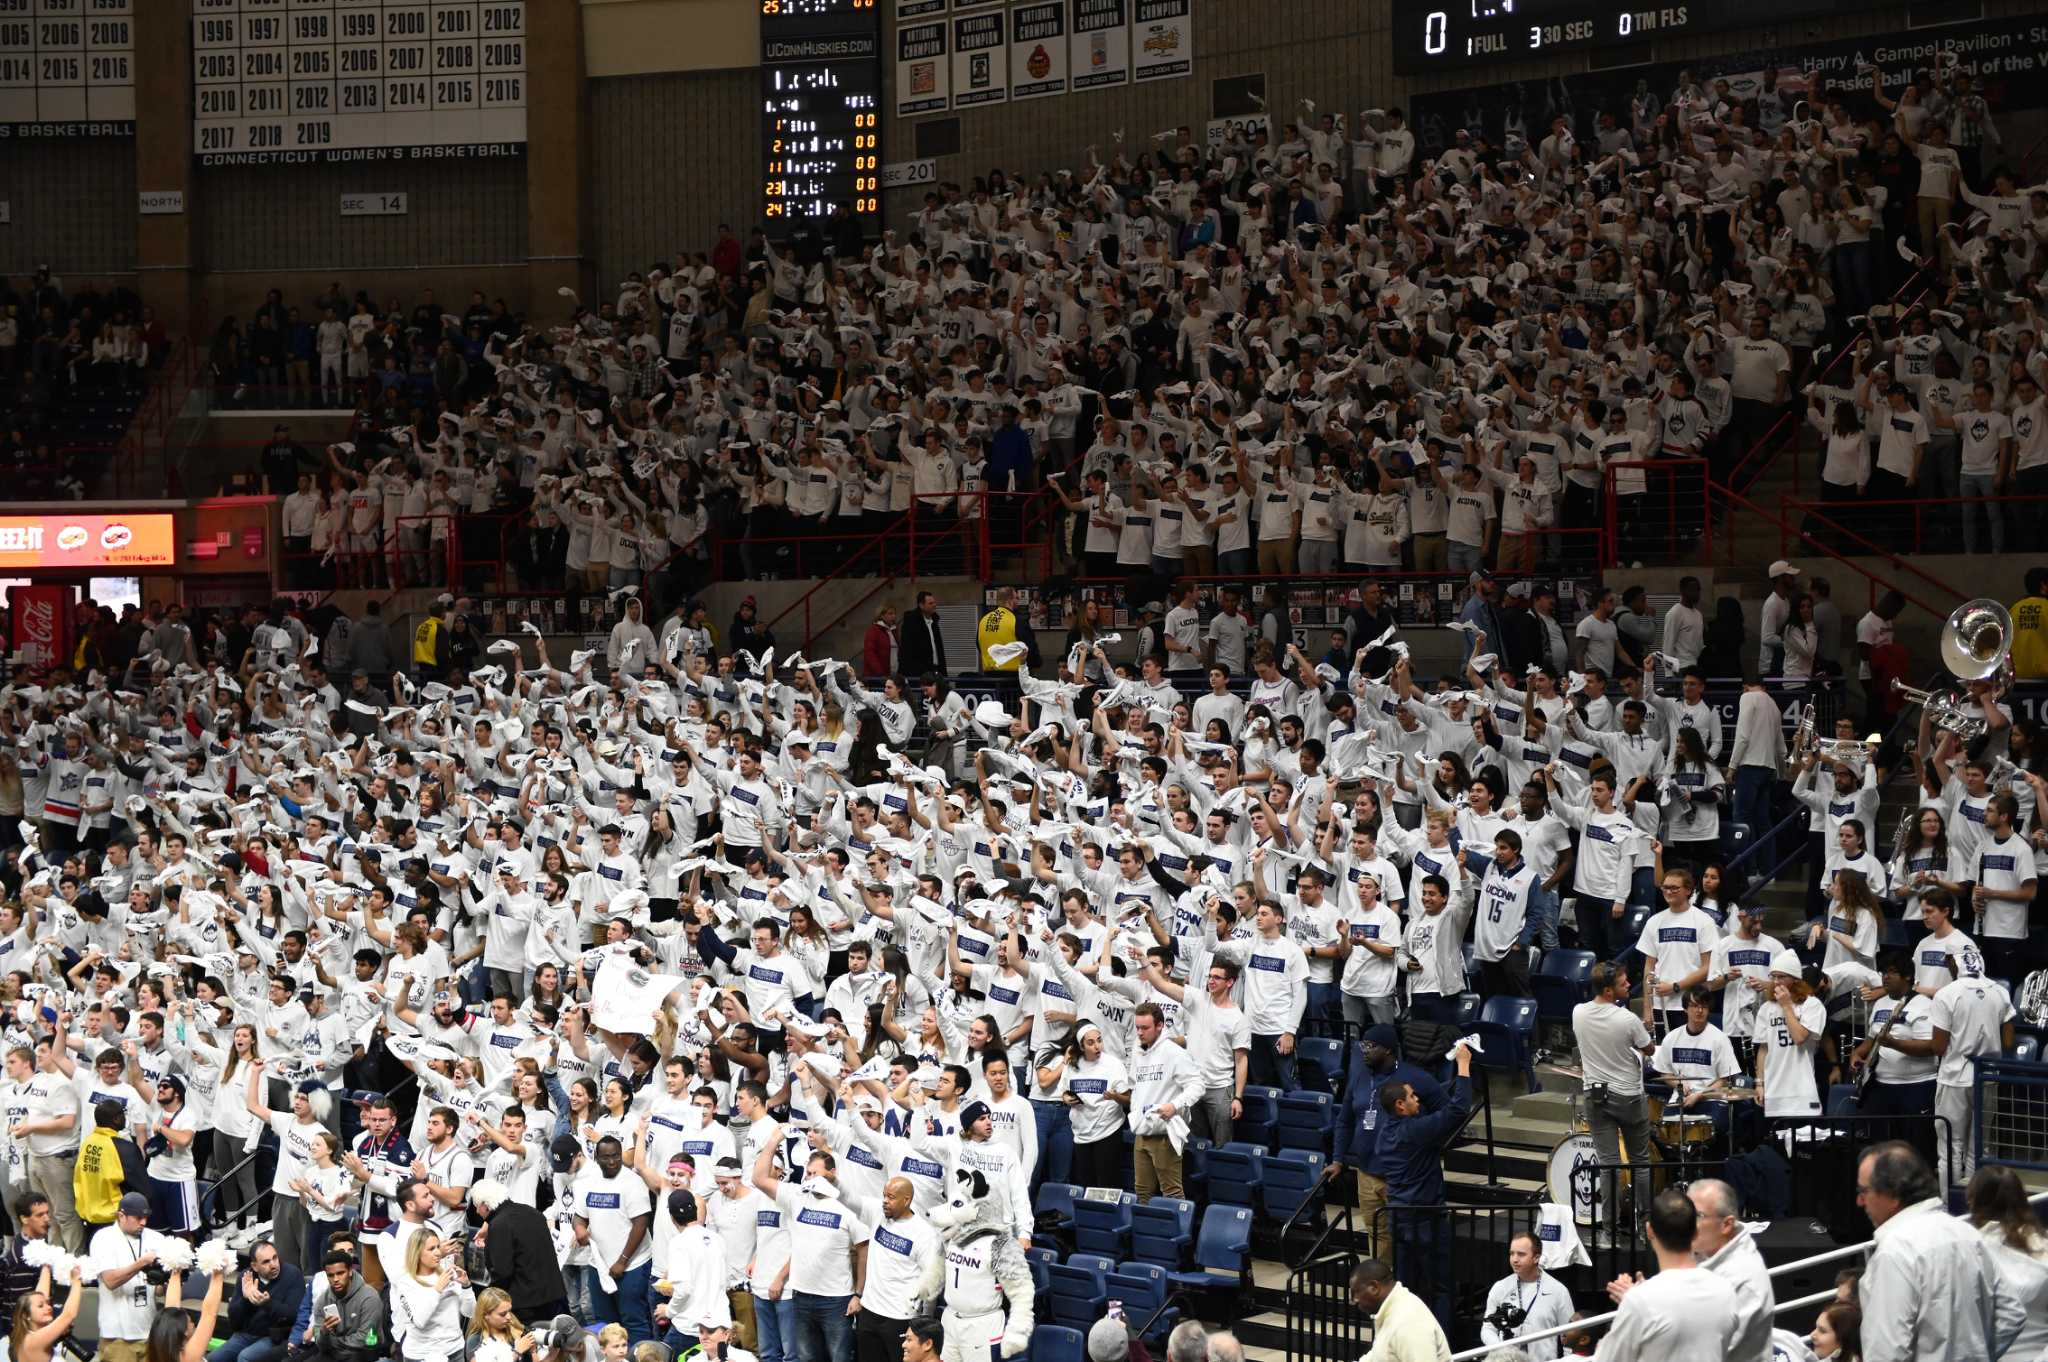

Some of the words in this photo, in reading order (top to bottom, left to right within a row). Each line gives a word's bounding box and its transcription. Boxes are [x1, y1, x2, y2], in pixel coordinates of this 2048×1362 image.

[763, 1, 778, 14] 25
[42, 24, 79, 44] 2006
[92, 23, 128, 44] 2008
[200, 20, 232, 42] 1996
[248, 18, 280, 40] 1997
[296, 16, 328, 38] 1998
[342, 14, 375, 36] 1999
[389, 12, 424, 34] 2000
[438, 10, 471, 32] 2001
[485, 8, 520, 30] 2002
[1425, 12, 1446, 54] 0
[1530, 26, 1540, 48] 3
[1543, 25, 1561, 44] 30
[1566, 20, 1592, 42] SEC
[1619, 13, 1631, 35] 0
[1634, 12, 1656, 31] TM
[1661, 6, 1688, 27] FLS
[1467, 38, 1472, 56] 1
[1474, 34, 1508, 54] FULL
[1804, 54, 1848, 72] Harry
[1874, 40, 1939, 64] Gampel
[1945, 32, 2010, 54] Pavilion
[200, 56, 234, 76] 2003
[247, 53, 282, 75] 2004
[294, 52, 329, 72] 2005
[342, 50, 376, 70] 2006
[390, 48, 424, 69] 2007
[437, 46, 472, 67] 2008
[486, 44, 520, 65] 2009
[44, 59, 78, 80] 2015
[93, 58, 127, 79] 2016
[1825, 68, 1912, 92] Baskeball
[1982, 58, 2000, 73] of
[2004, 54, 2033, 71] the
[202, 91, 235, 112] 2010
[250, 88, 282, 110] 2011
[296, 87, 328, 108] 2012
[344, 85, 376, 107] 2013
[390, 83, 424, 104] 2014
[438, 81, 472, 102] 2015
[486, 79, 520, 101] 2016
[19, 124, 134, 136] BASKETBALL
[776, 120, 782, 130] 1
[1209, 128, 1222, 138] SE
[202, 128, 234, 149] 2017
[250, 126, 282, 147] 2018
[298, 122, 330, 144] 2019
[774, 140, 781, 152] 2
[202, 152, 318, 166] CONNECTICUT
[327, 148, 403, 162] WOMEN'S
[411, 144, 520, 158] BASKETBALL
[770, 162, 782, 174] 11
[884, 170, 900, 180] SEC
[908, 164, 936, 180] 201
[766, 182, 782, 196] 23
[141, 198, 182, 206] NORTH
[343, 200, 364, 210] SEC
[380, 196, 400, 210] 14
[766, 204, 782, 217] 24
[940, 322, 960, 339] 39
[2020, 605, 2040, 614] CSC
[586, 640, 604, 650] SEC
[1485, 882, 1516, 903] UCONN
[1176, 908, 1202, 927] CONN
[1488, 898, 1502, 923] 15
[558, 1058, 586, 1072] UCONN
[991, 1111, 1016, 1123] ONN
[288, 1130, 313, 1151] UCONN
[1578, 1140, 1595, 1148] YAMA
[86, 1144, 103, 1157] CSC
[954, 1268, 960, 1288] 1
